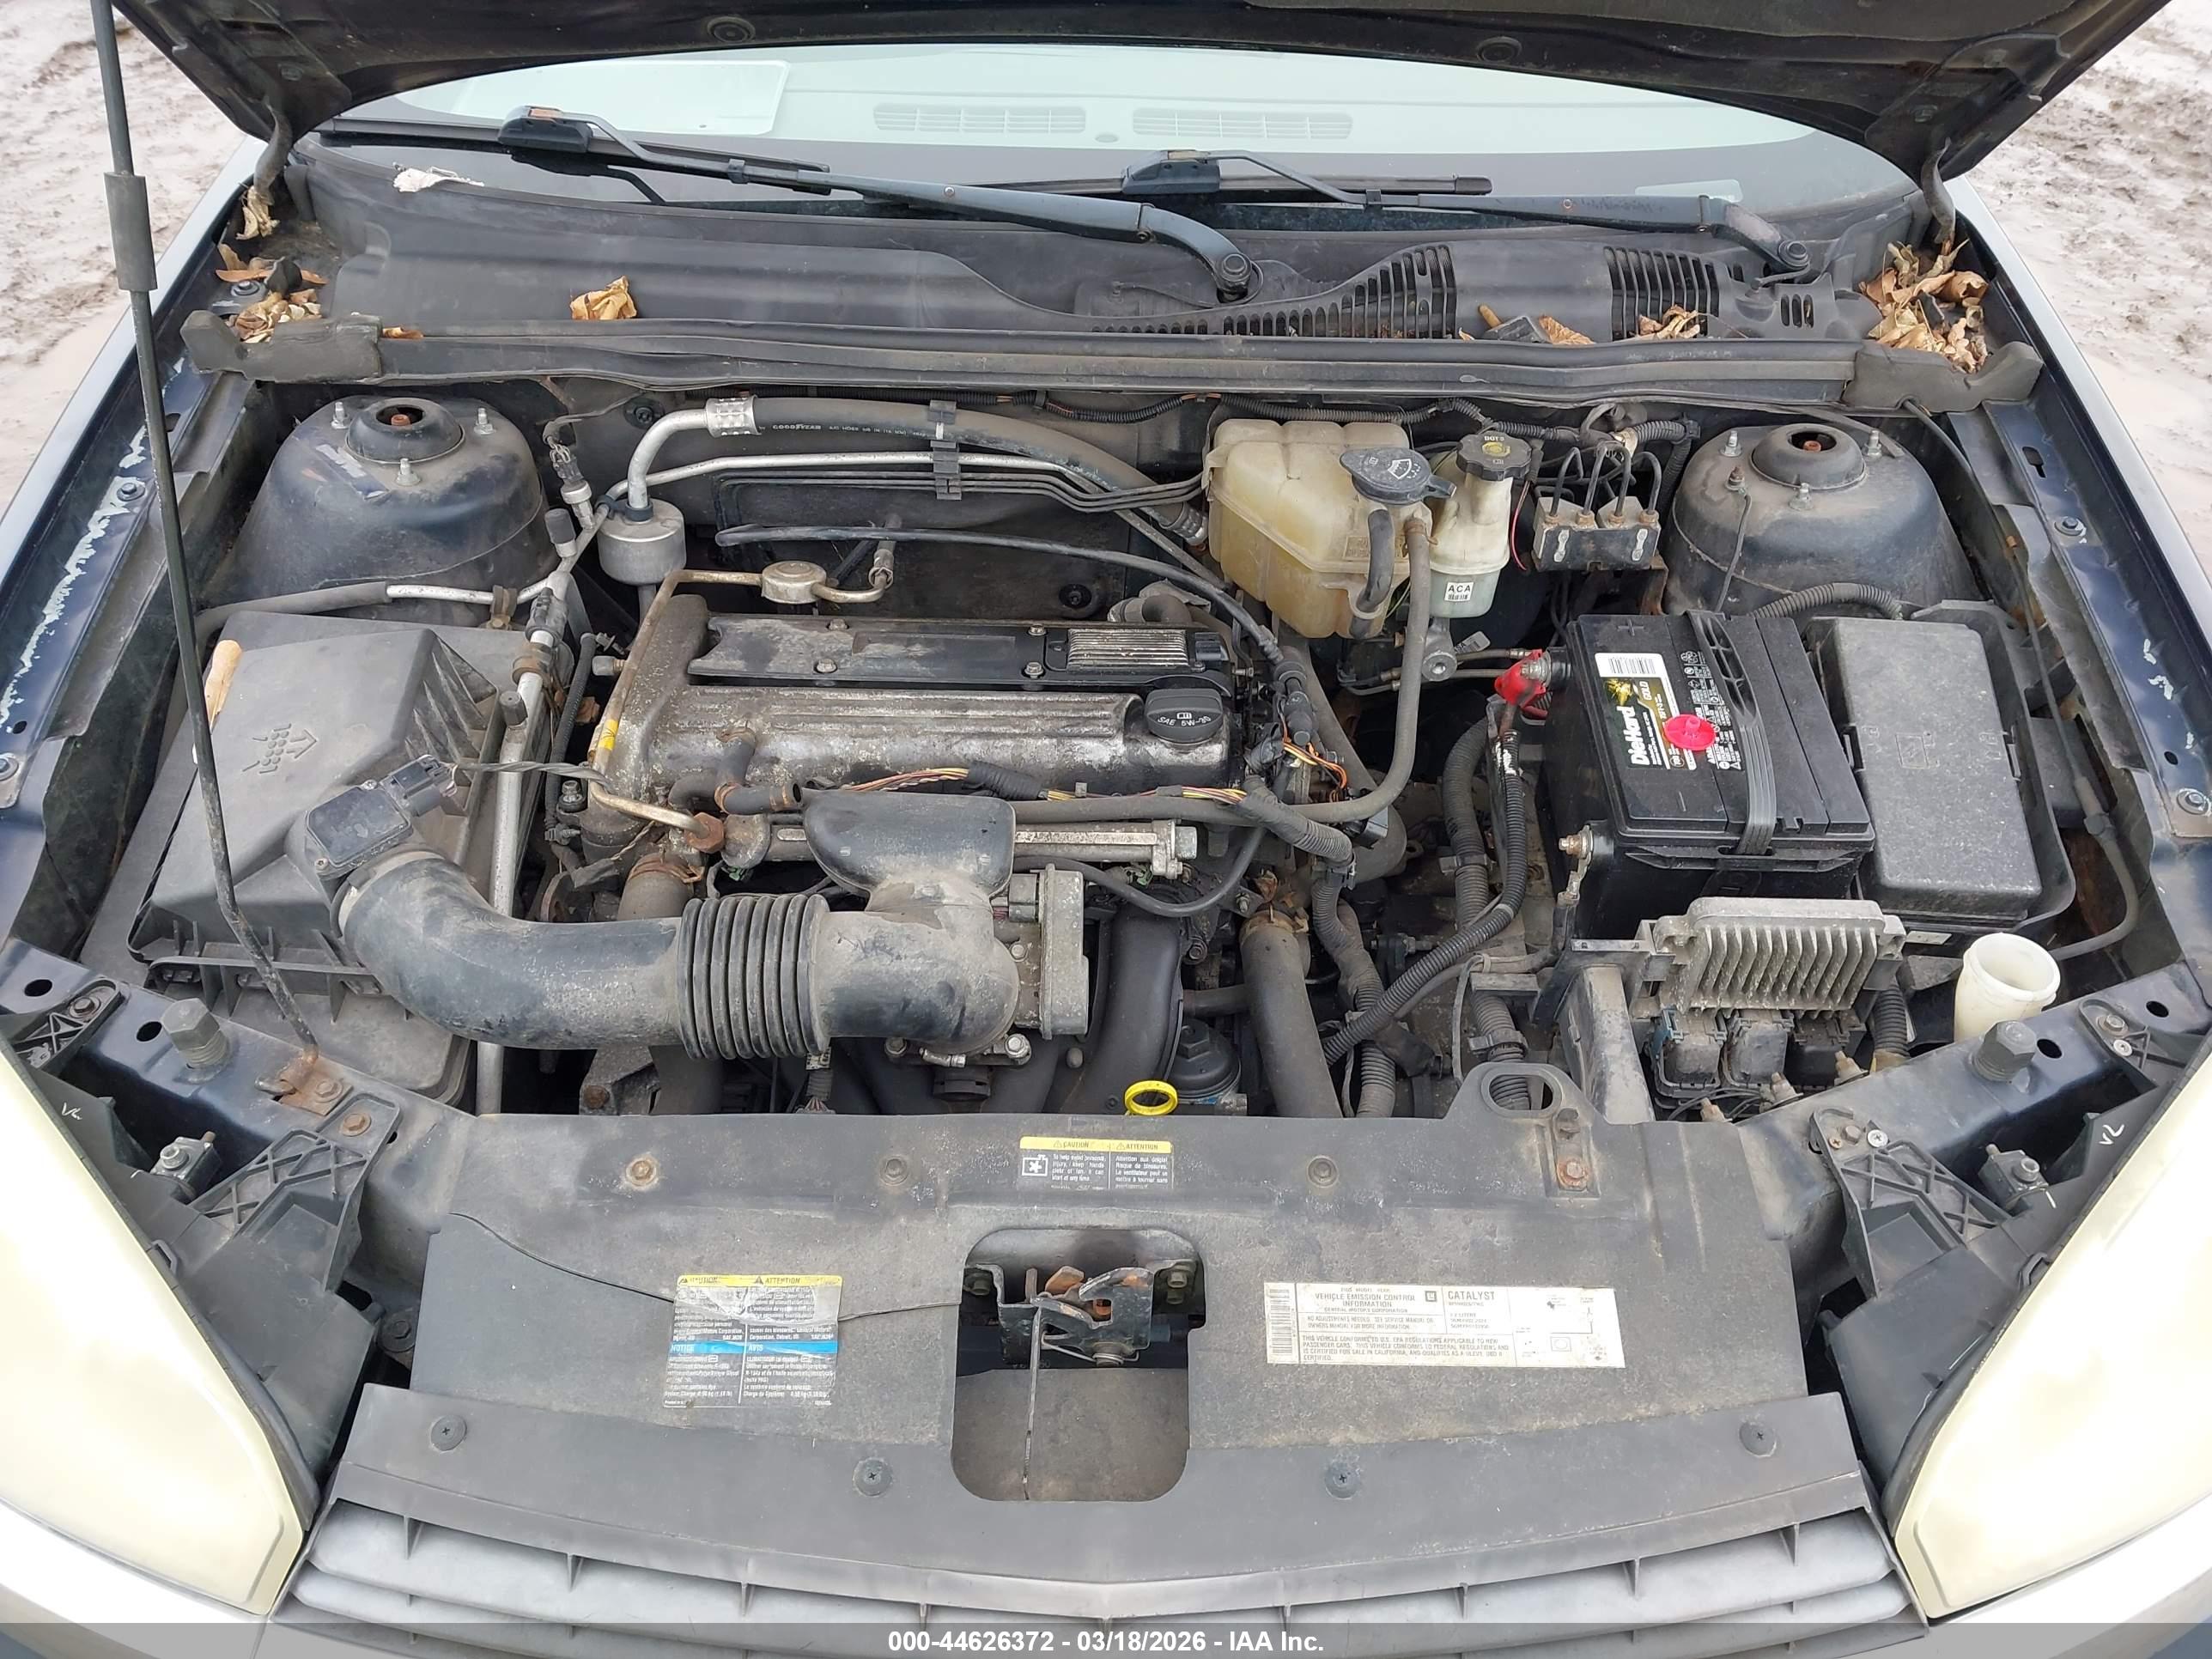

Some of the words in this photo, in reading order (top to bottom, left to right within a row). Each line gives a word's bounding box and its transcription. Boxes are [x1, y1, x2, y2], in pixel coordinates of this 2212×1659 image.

[1639, 681, 1652, 701] GOLD
[1158, 716, 1176, 726] SAE
[1616, 705, 1650, 766] DieHard
[1315, 1292, 1345, 1301] VEHICLE
[1383, 1293, 1415, 1302] CONTROL
[1448, 1291, 1496, 1301] CATALYST
